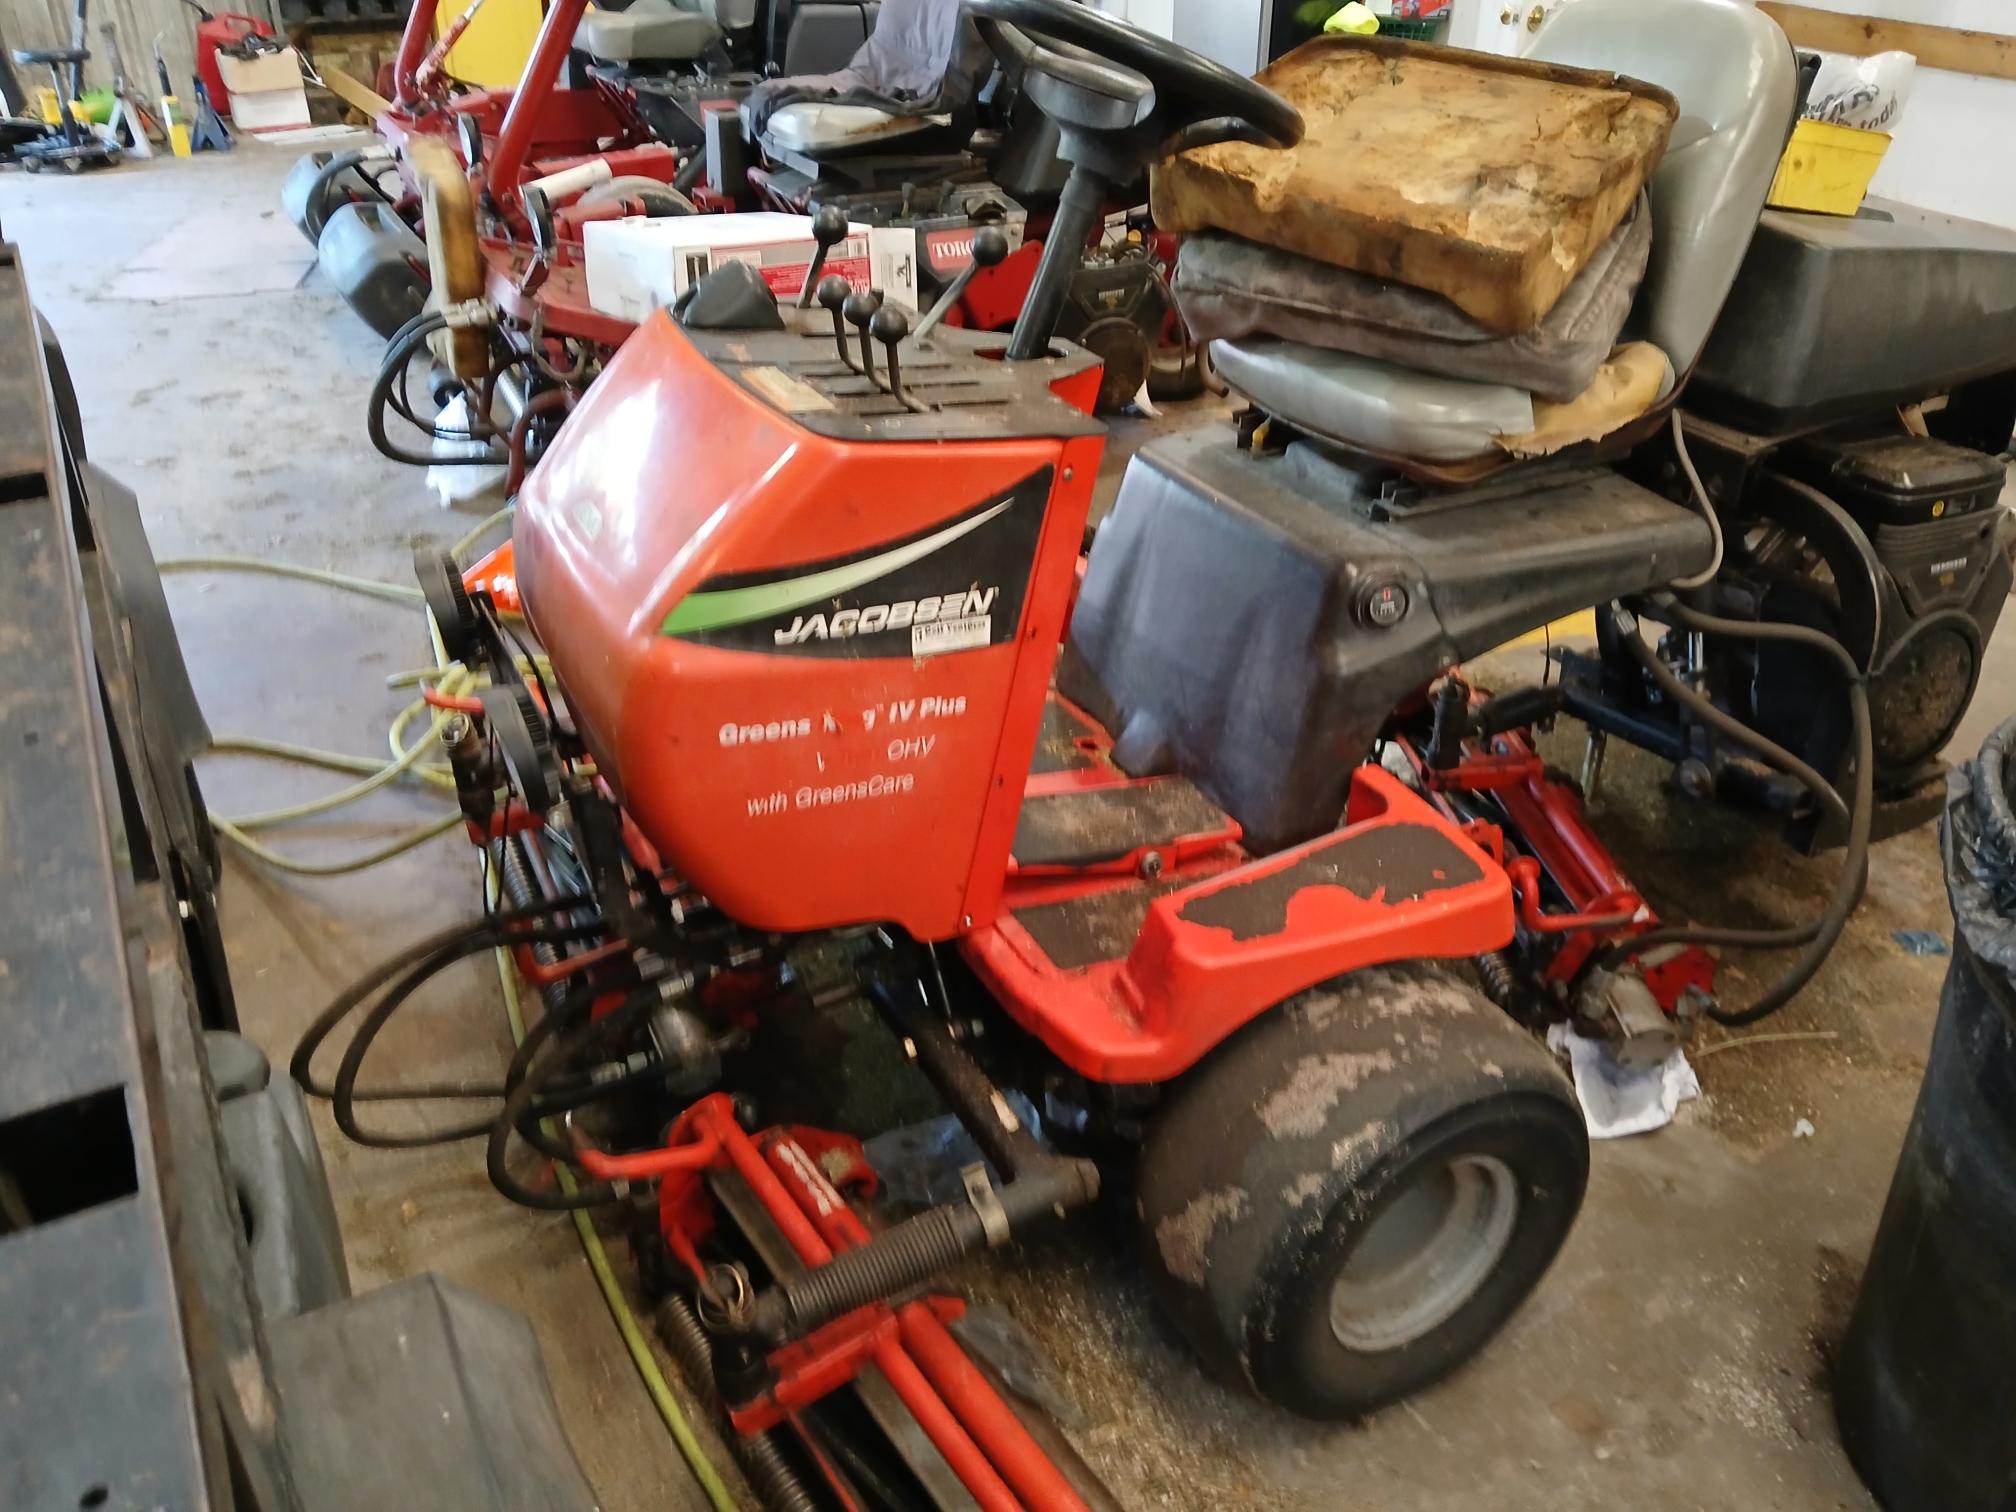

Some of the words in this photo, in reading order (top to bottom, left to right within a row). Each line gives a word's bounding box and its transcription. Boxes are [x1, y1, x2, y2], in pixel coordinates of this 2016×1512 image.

[774, 586, 995, 645] JACOBSEN
[719, 718, 811, 747] Greens
[889, 699, 916, 724] IV
[920, 695, 967, 719] Plus
[888, 734, 936, 762] OHV
[747, 790, 788, 817] with
[795, 773, 914, 809] GreensCare
